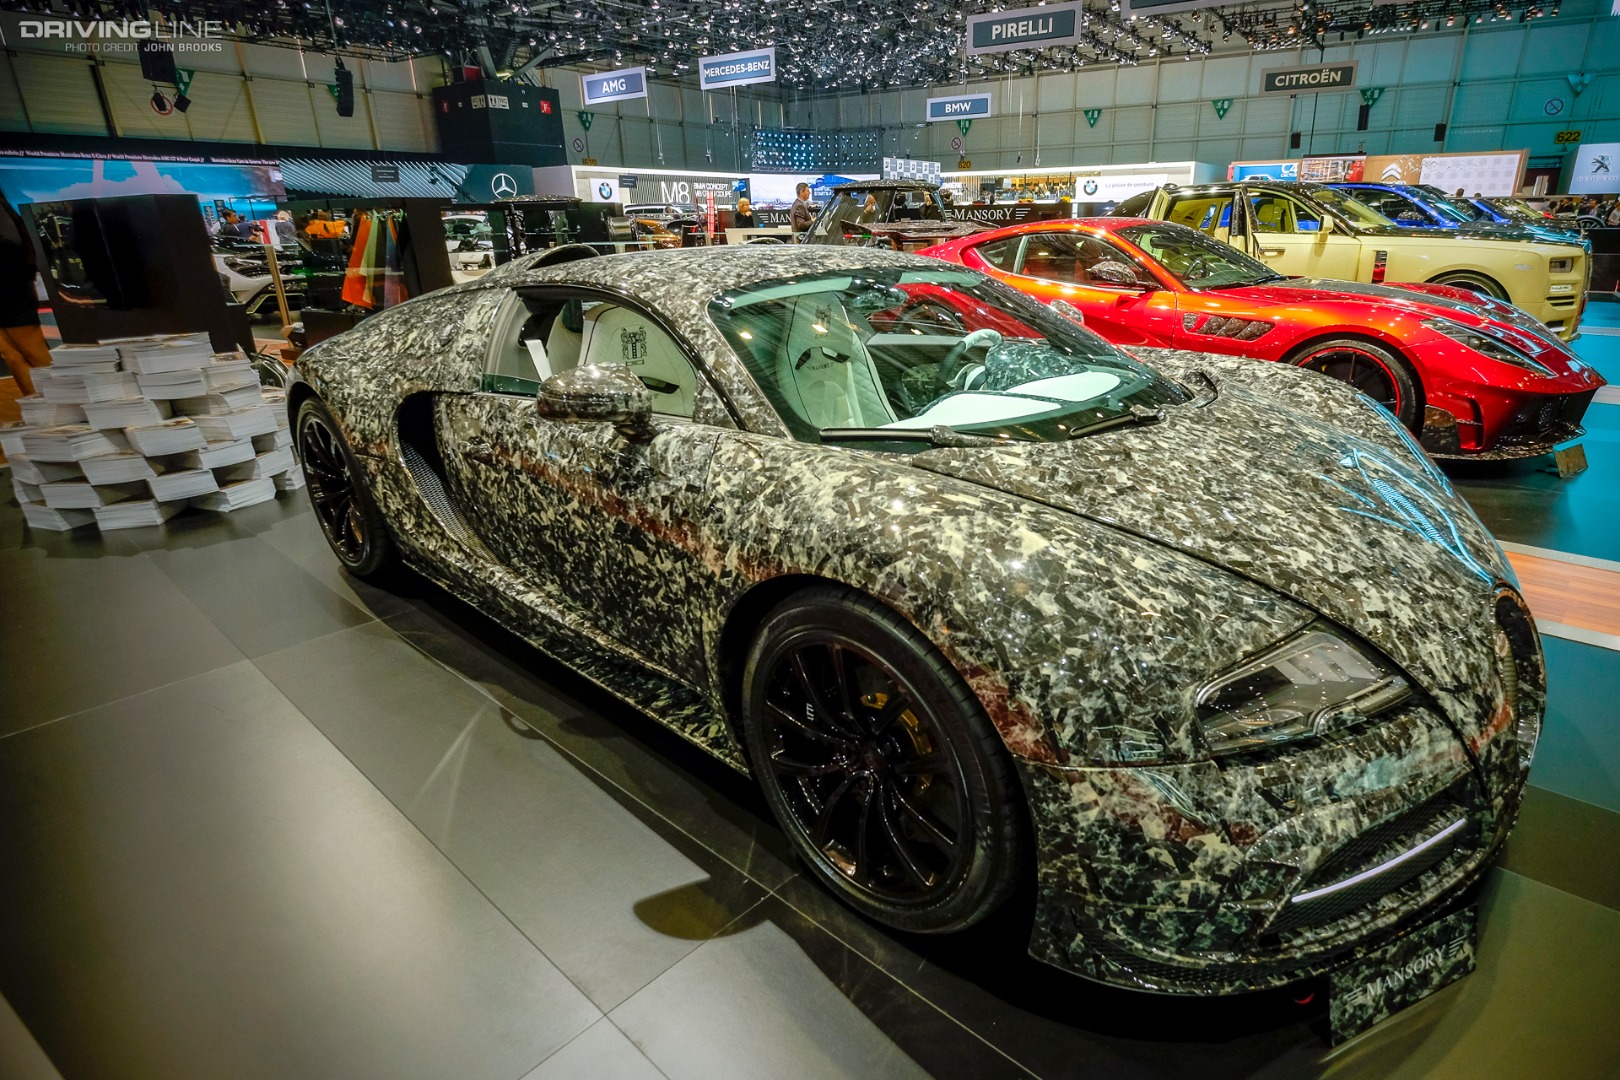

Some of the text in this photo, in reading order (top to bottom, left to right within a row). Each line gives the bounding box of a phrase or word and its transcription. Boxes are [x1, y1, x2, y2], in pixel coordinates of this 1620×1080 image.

[991, 17, 1053, 40] PIRELLI
[703, 60, 770, 78] MERCEDES-BENZ
[1274, 68, 1342, 87] CITROËN
[601, 78, 627, 94] AMG
[945, 101, 972, 114] BMW
[1556, 131, 1581, 142] 622
[661, 181, 690, 204] M8
[954, 207, 1013, 220] MANSORY
[1366, 944, 1446, 997] MANSORY
